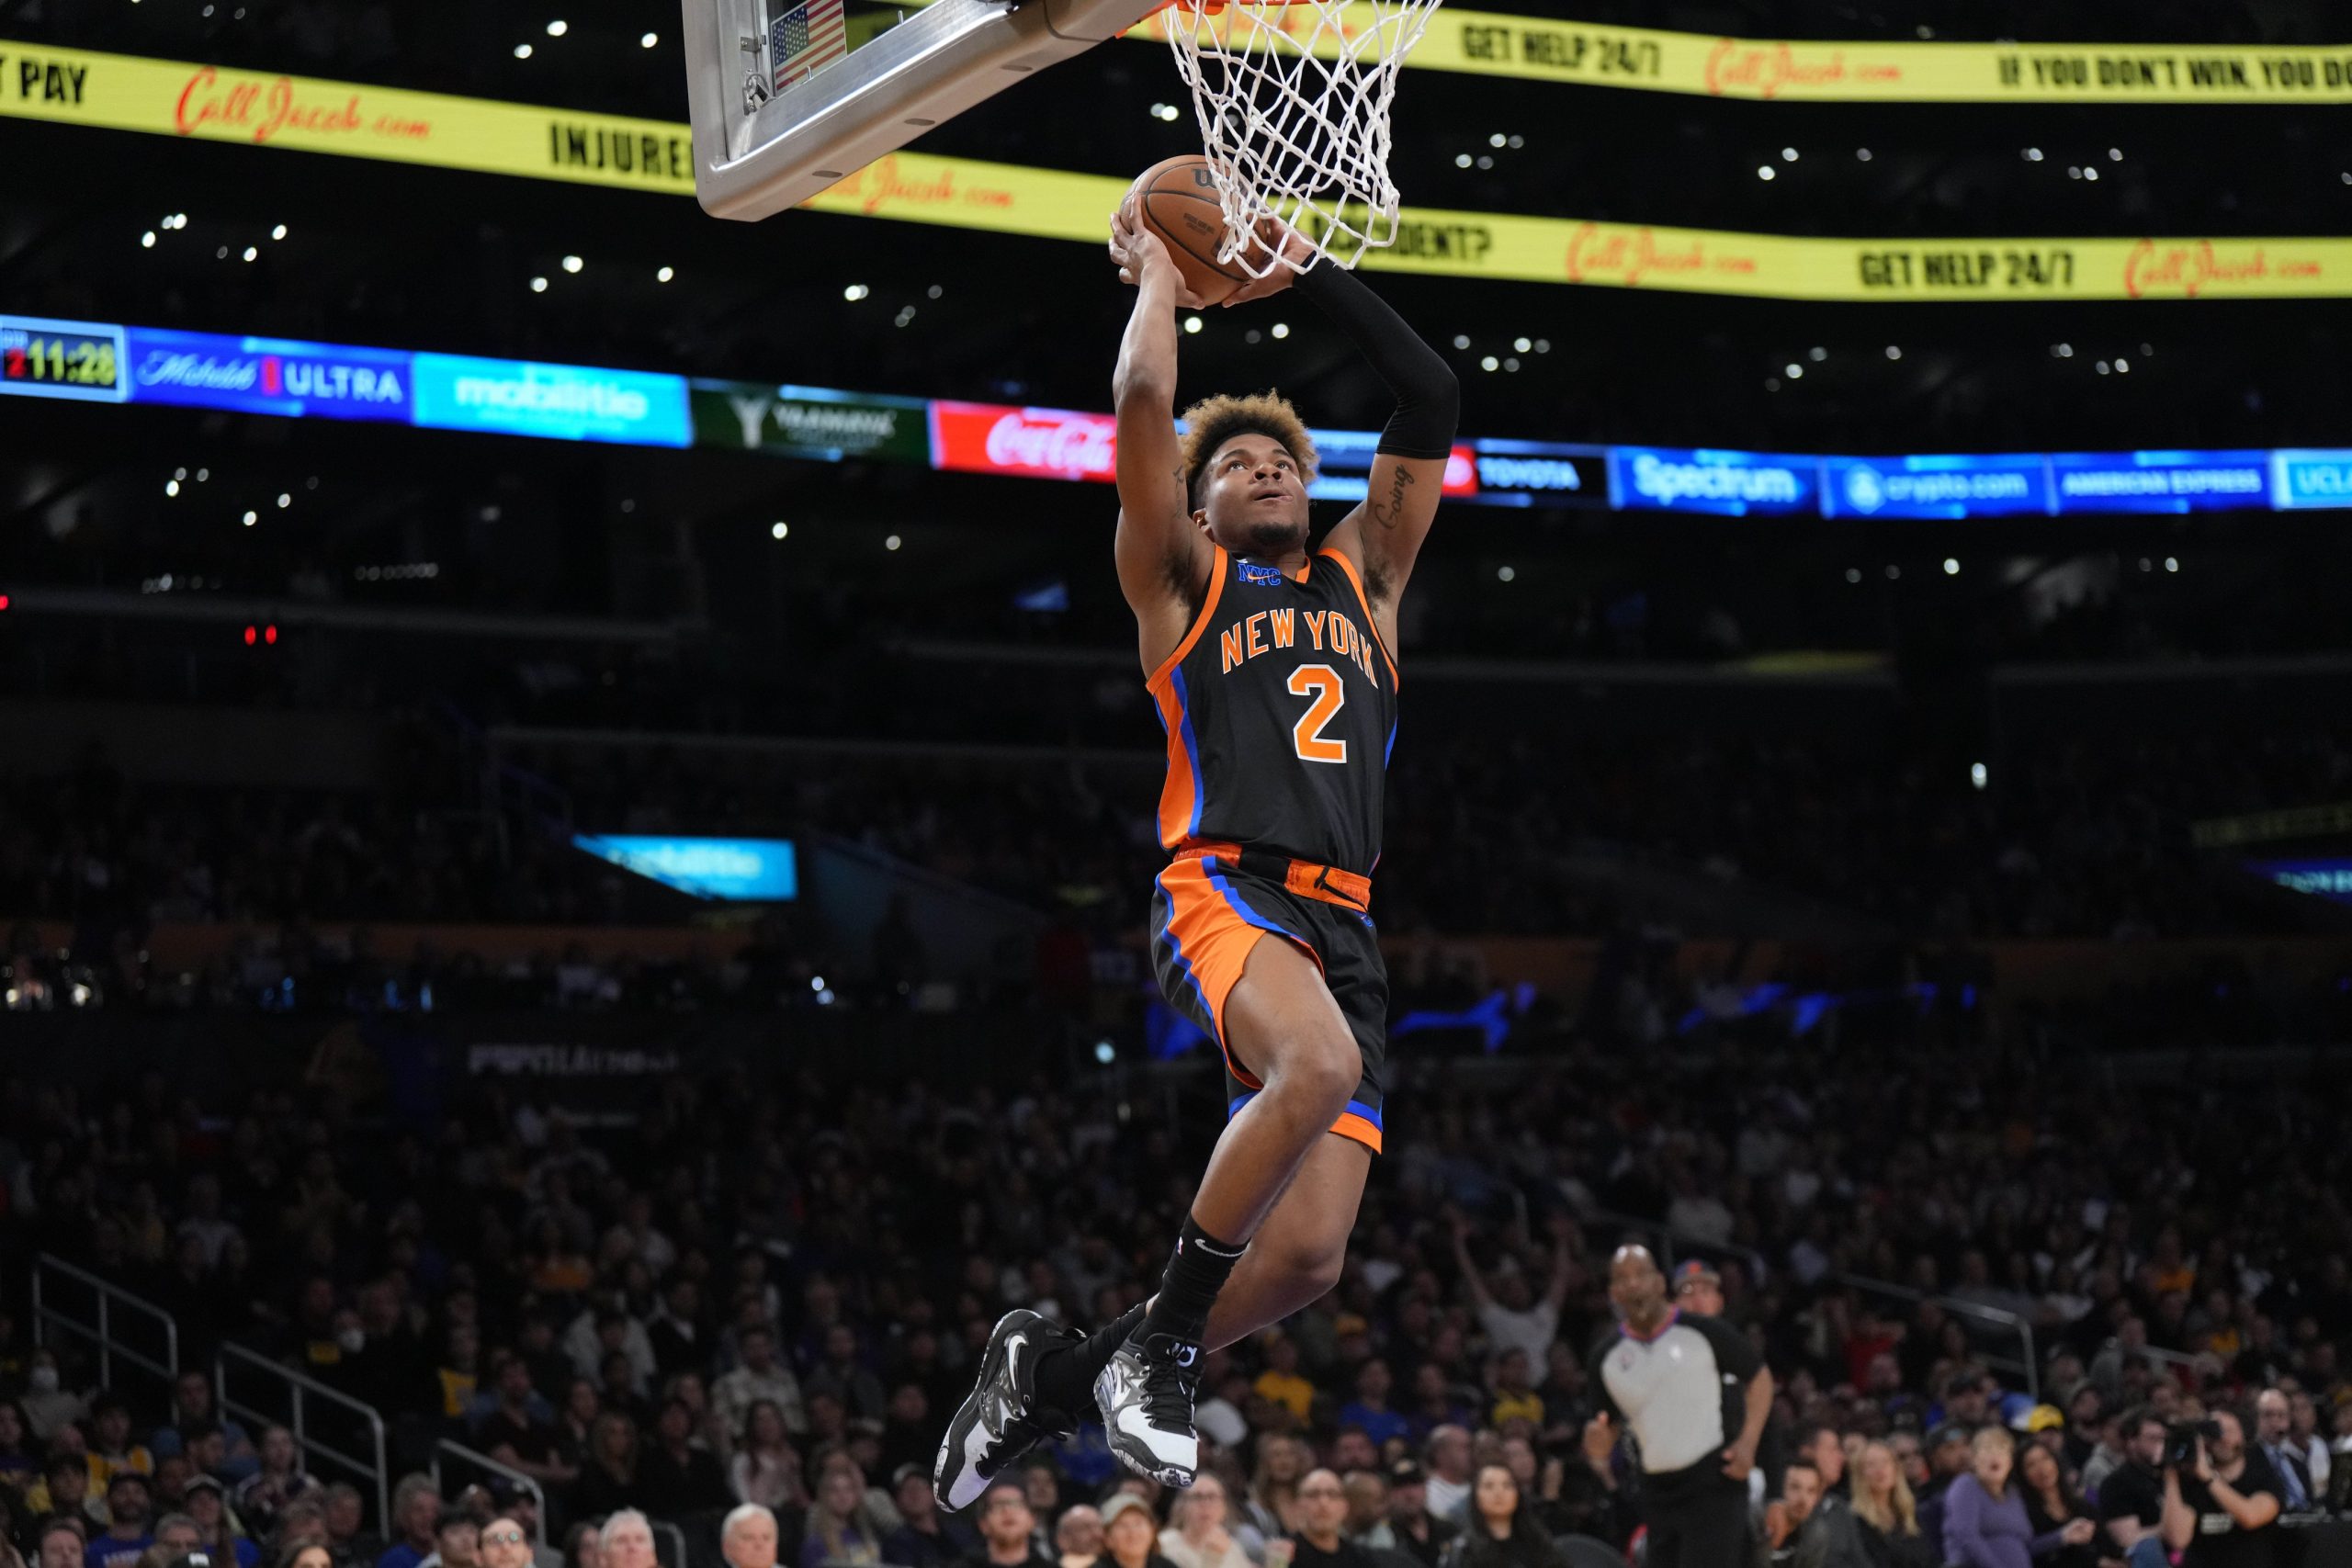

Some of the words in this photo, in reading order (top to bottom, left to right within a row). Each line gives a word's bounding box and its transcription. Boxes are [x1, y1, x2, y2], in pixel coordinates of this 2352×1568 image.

[1461, 24, 1510, 62] GET
[1521, 30, 1587, 69] HELP
[1596, 37, 1661, 77] 24/7
[1998, 58, 2020, 86] IF
[2030, 58, 2088, 86] YOU
[2097, 58, 2176, 87] DON'T
[2260, 59, 2315, 89] YOU
[19, 59, 85, 105] PAY
[549, 123, 696, 180] INJURE
[1860, 251, 1911, 287] GET
[1923, 252, 1996, 287] HELP
[2003, 250, 2074, 287] 24/7
[6, 346, 27, 378] 2
[28, 337, 116, 386] 11:28
[283, 361, 404, 404] ULTRA
[1374, 463, 1415, 530] Going
[1475, 457, 1580, 490] TOYOTA
[1632, 454, 1798, 505] Spectrum
[1885, 473, 2029, 502] crypto.com
[2062, 470, 2169, 498] AMERICAN
[2170, 468, 2262, 494] EXPRESS
[1238, 563, 1282, 586] NYC
[1220, 607, 1295, 675] NEW
[1302, 610, 1379, 690] YORK
[1286, 663, 1348, 764] 2
